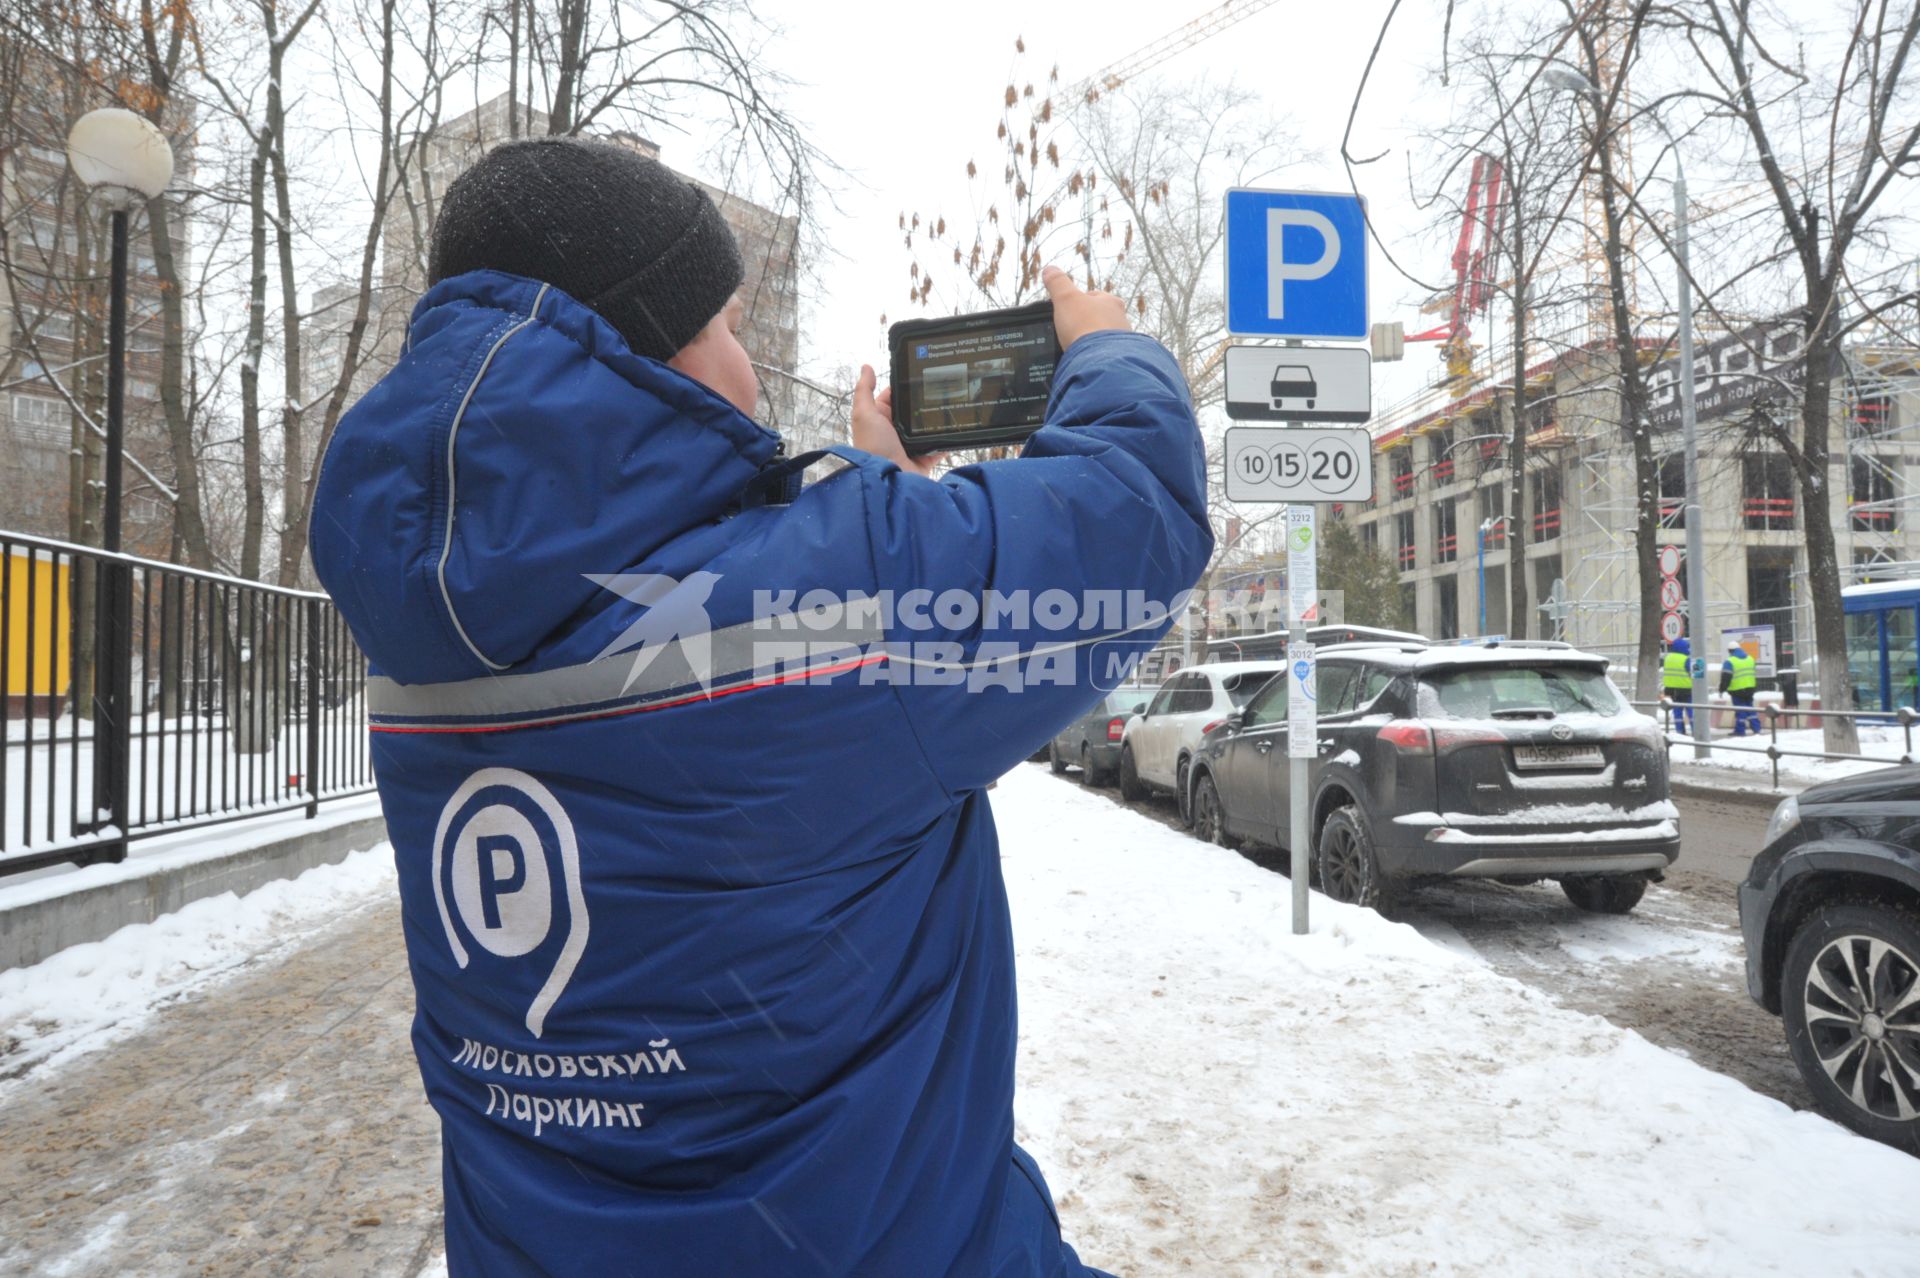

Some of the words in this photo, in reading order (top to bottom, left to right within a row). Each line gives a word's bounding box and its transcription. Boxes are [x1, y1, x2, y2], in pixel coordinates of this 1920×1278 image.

[1267, 208, 1341, 319] P
[1244, 455, 1264, 474] 10
[1274, 453, 1300, 477] 15
[1311, 450, 1352, 480] 20
[1291, 514, 1311, 522] 3212
[1667, 623, 1678, 634] 10
[1291, 650, 1312, 659] 3012
[476, 834, 526, 929] P
[451, 1038, 686, 1079] Московский
[485, 1084, 644, 1136] Паркинг
